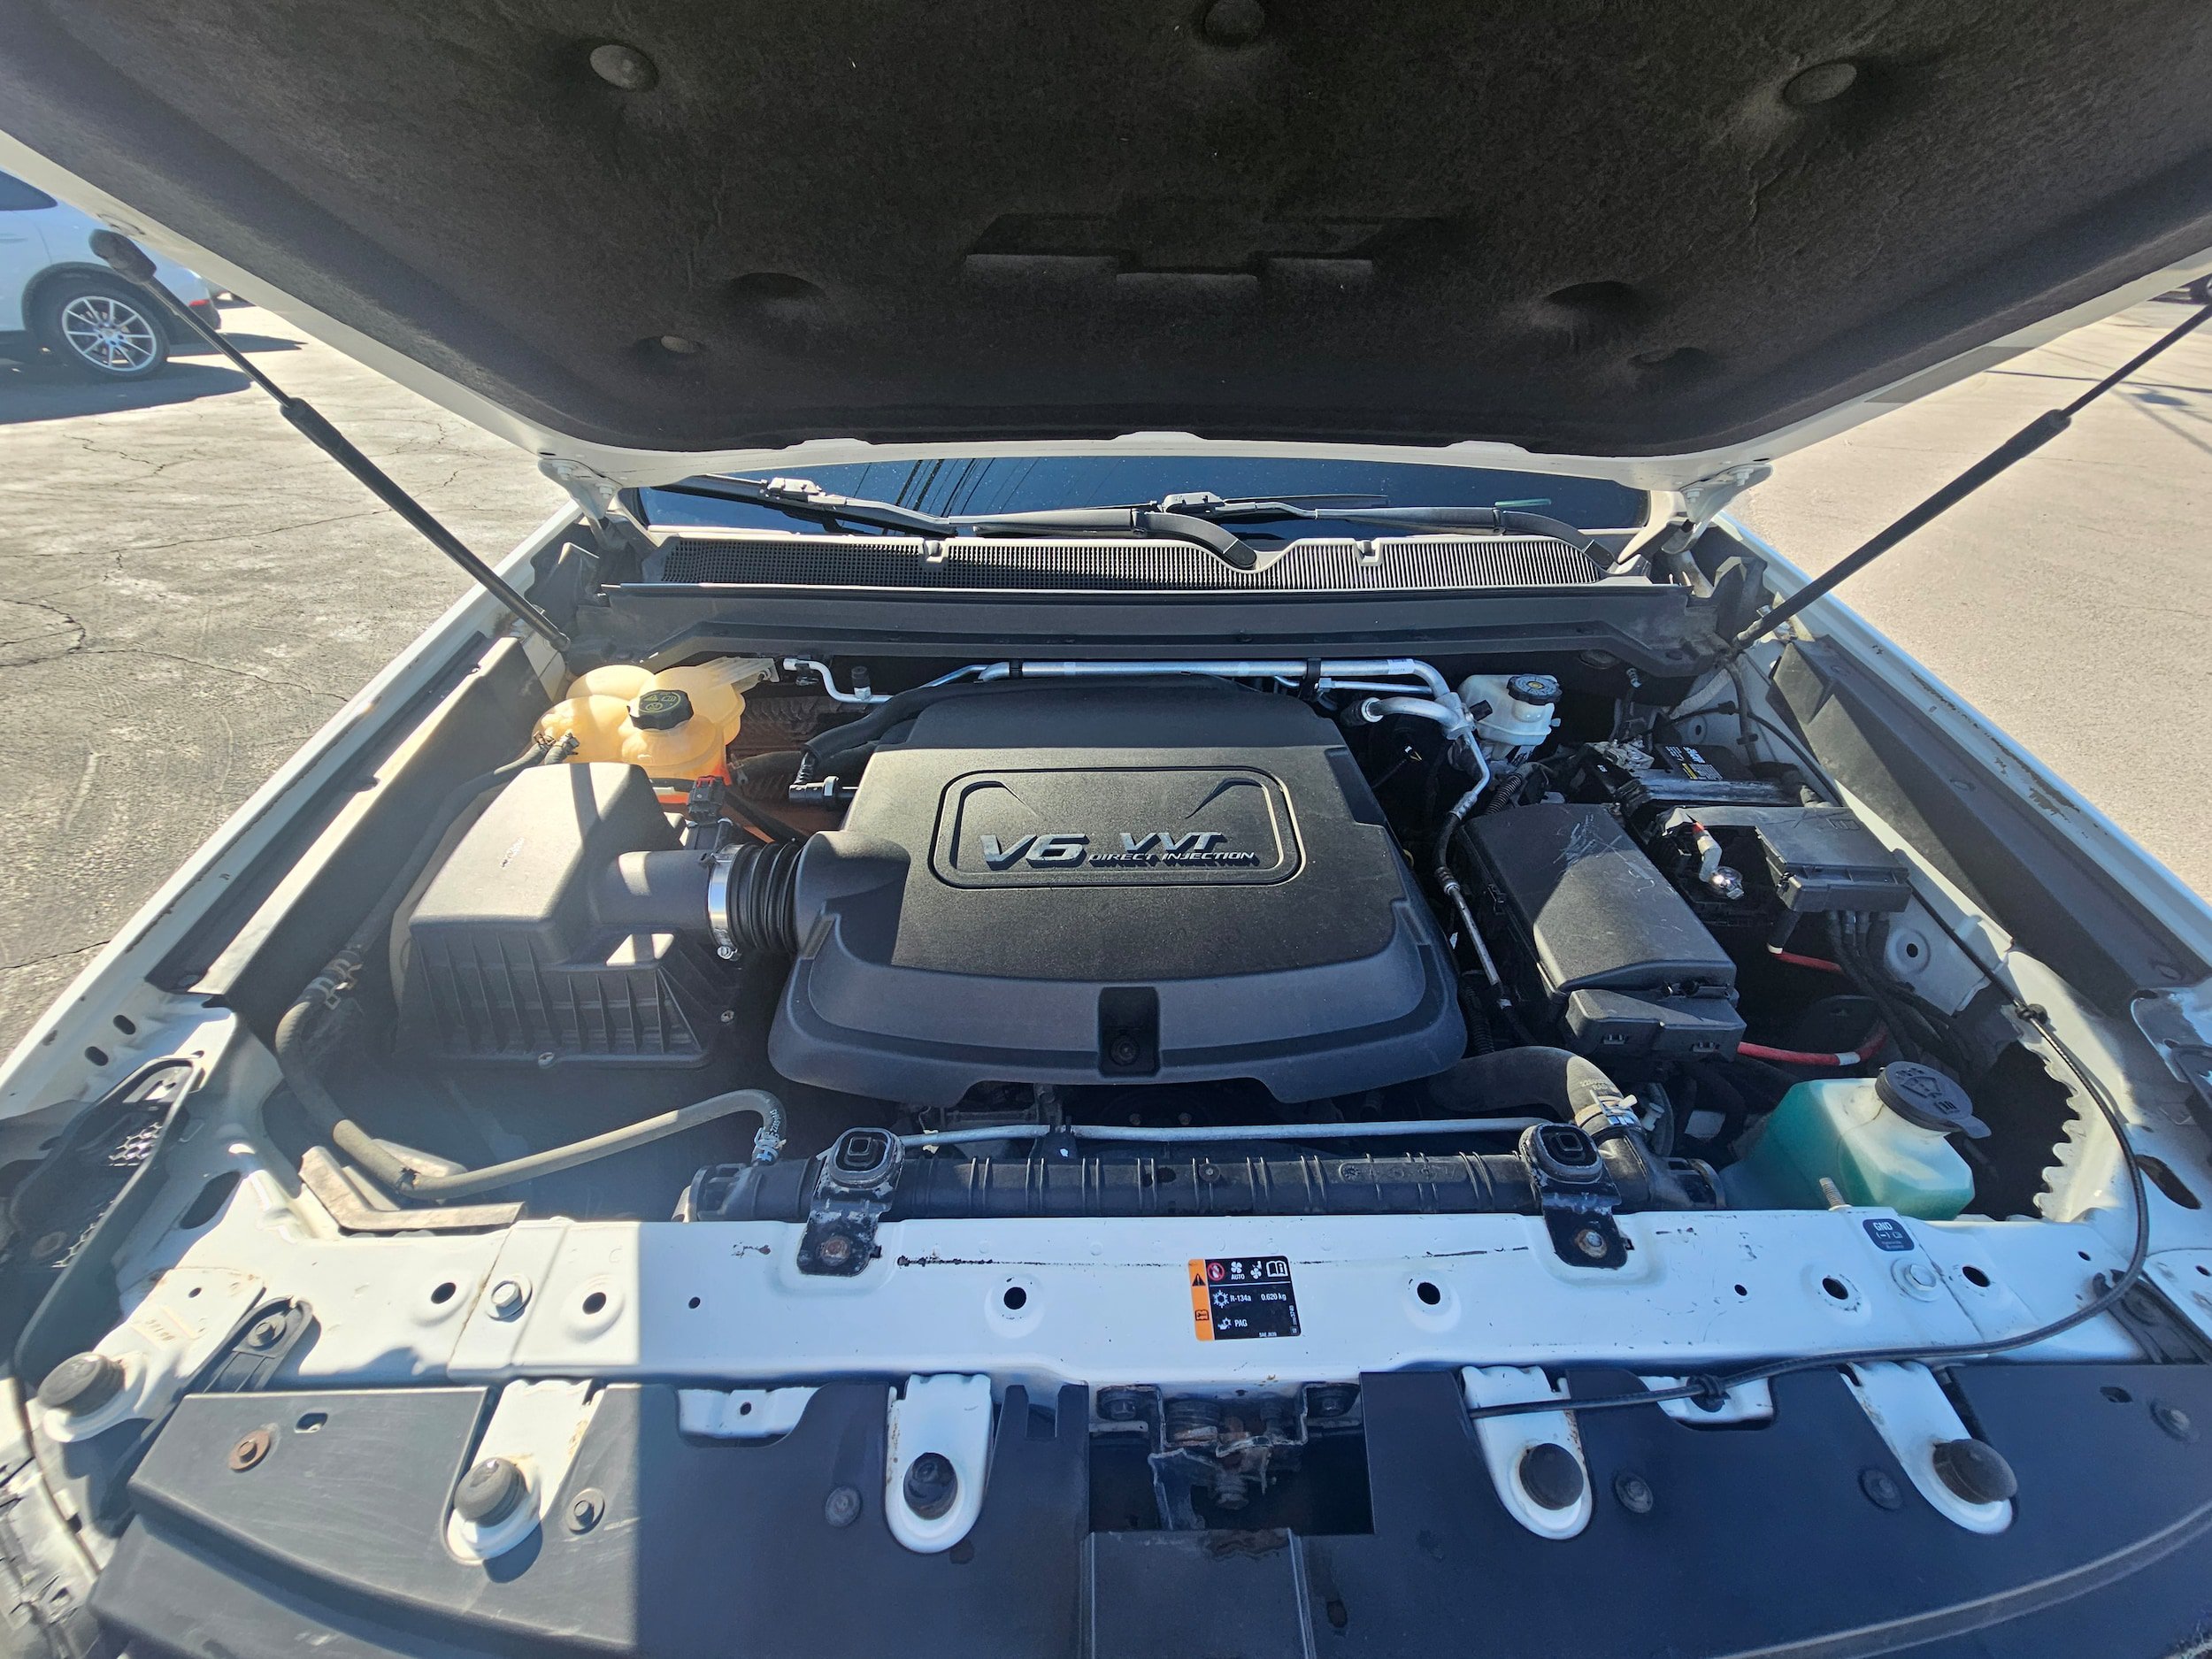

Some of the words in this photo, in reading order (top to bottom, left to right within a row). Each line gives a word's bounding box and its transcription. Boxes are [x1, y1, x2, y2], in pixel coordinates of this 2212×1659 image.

[1120, 832, 1224, 852] VVT
[980, 833, 1087, 864] V6
[1088, 852, 1158, 864] DIRECT
[1161, 851, 1256, 863] INJECTION
[1873, 1222, 1893, 1231] GND
[1230, 1294, 1252, 1302] R-134a
[1278, 1293, 1287, 1302] kg
[1234, 1318, 1248, 1327] PAG
